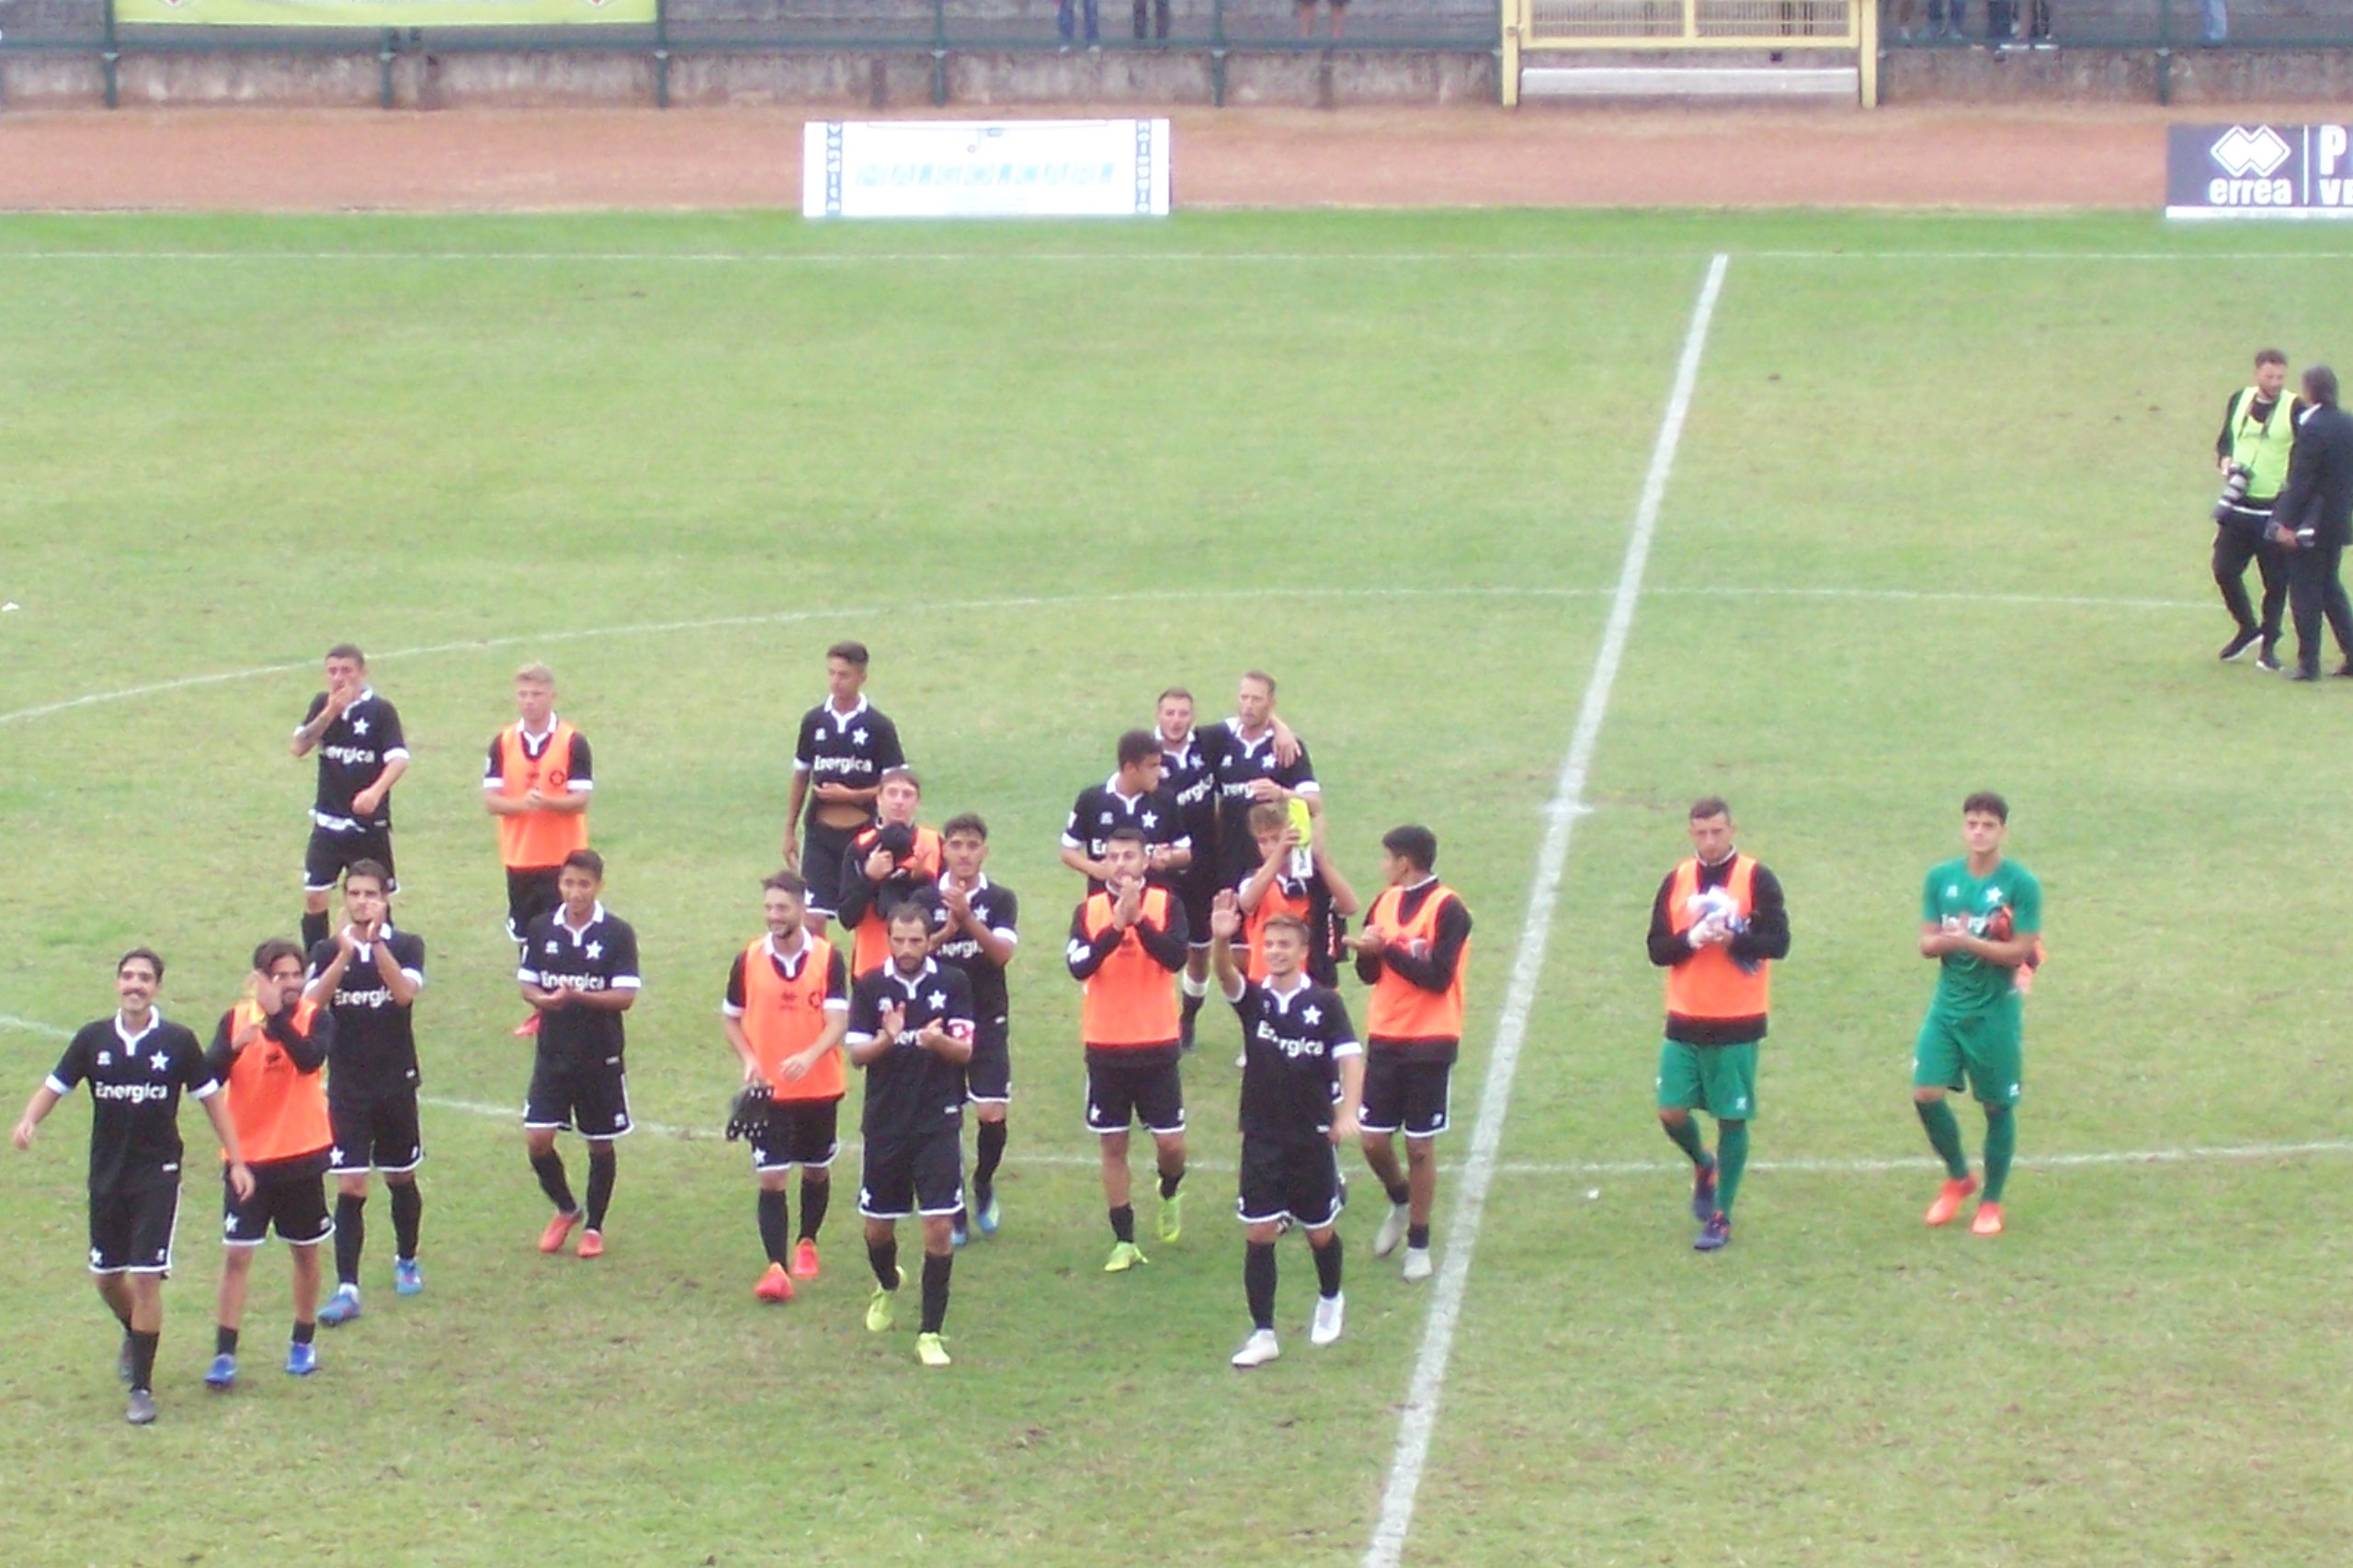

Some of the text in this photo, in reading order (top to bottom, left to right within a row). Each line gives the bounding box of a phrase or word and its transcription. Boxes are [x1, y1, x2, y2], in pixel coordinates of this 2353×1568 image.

[2209, 177, 2291, 205] errea
[334, 985, 394, 1008] Energic
[95, 1080, 168, 1104] Energica
